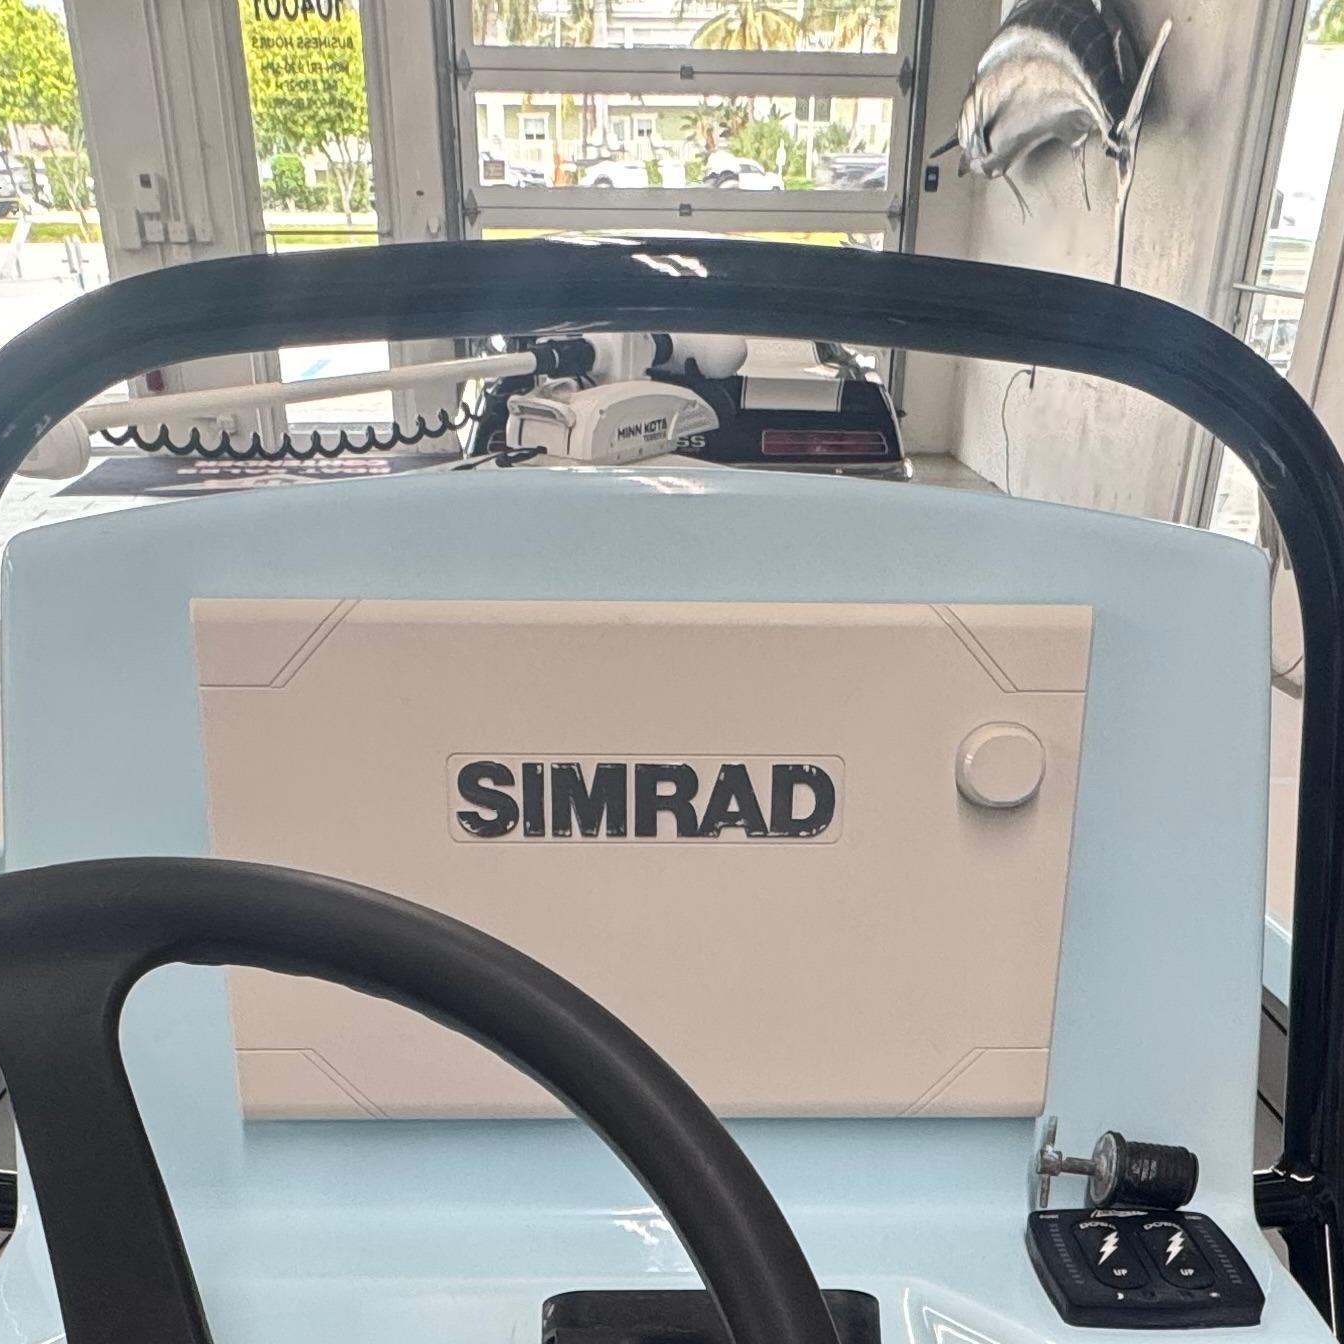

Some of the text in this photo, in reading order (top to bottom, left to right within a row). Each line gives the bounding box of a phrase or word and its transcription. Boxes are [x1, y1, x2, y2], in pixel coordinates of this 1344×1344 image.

[617, 417, 667, 440] MINN KOTA
[456, 760, 837, 838] SIMRAD
[1113, 1268, 1195, 1277] UP UP
